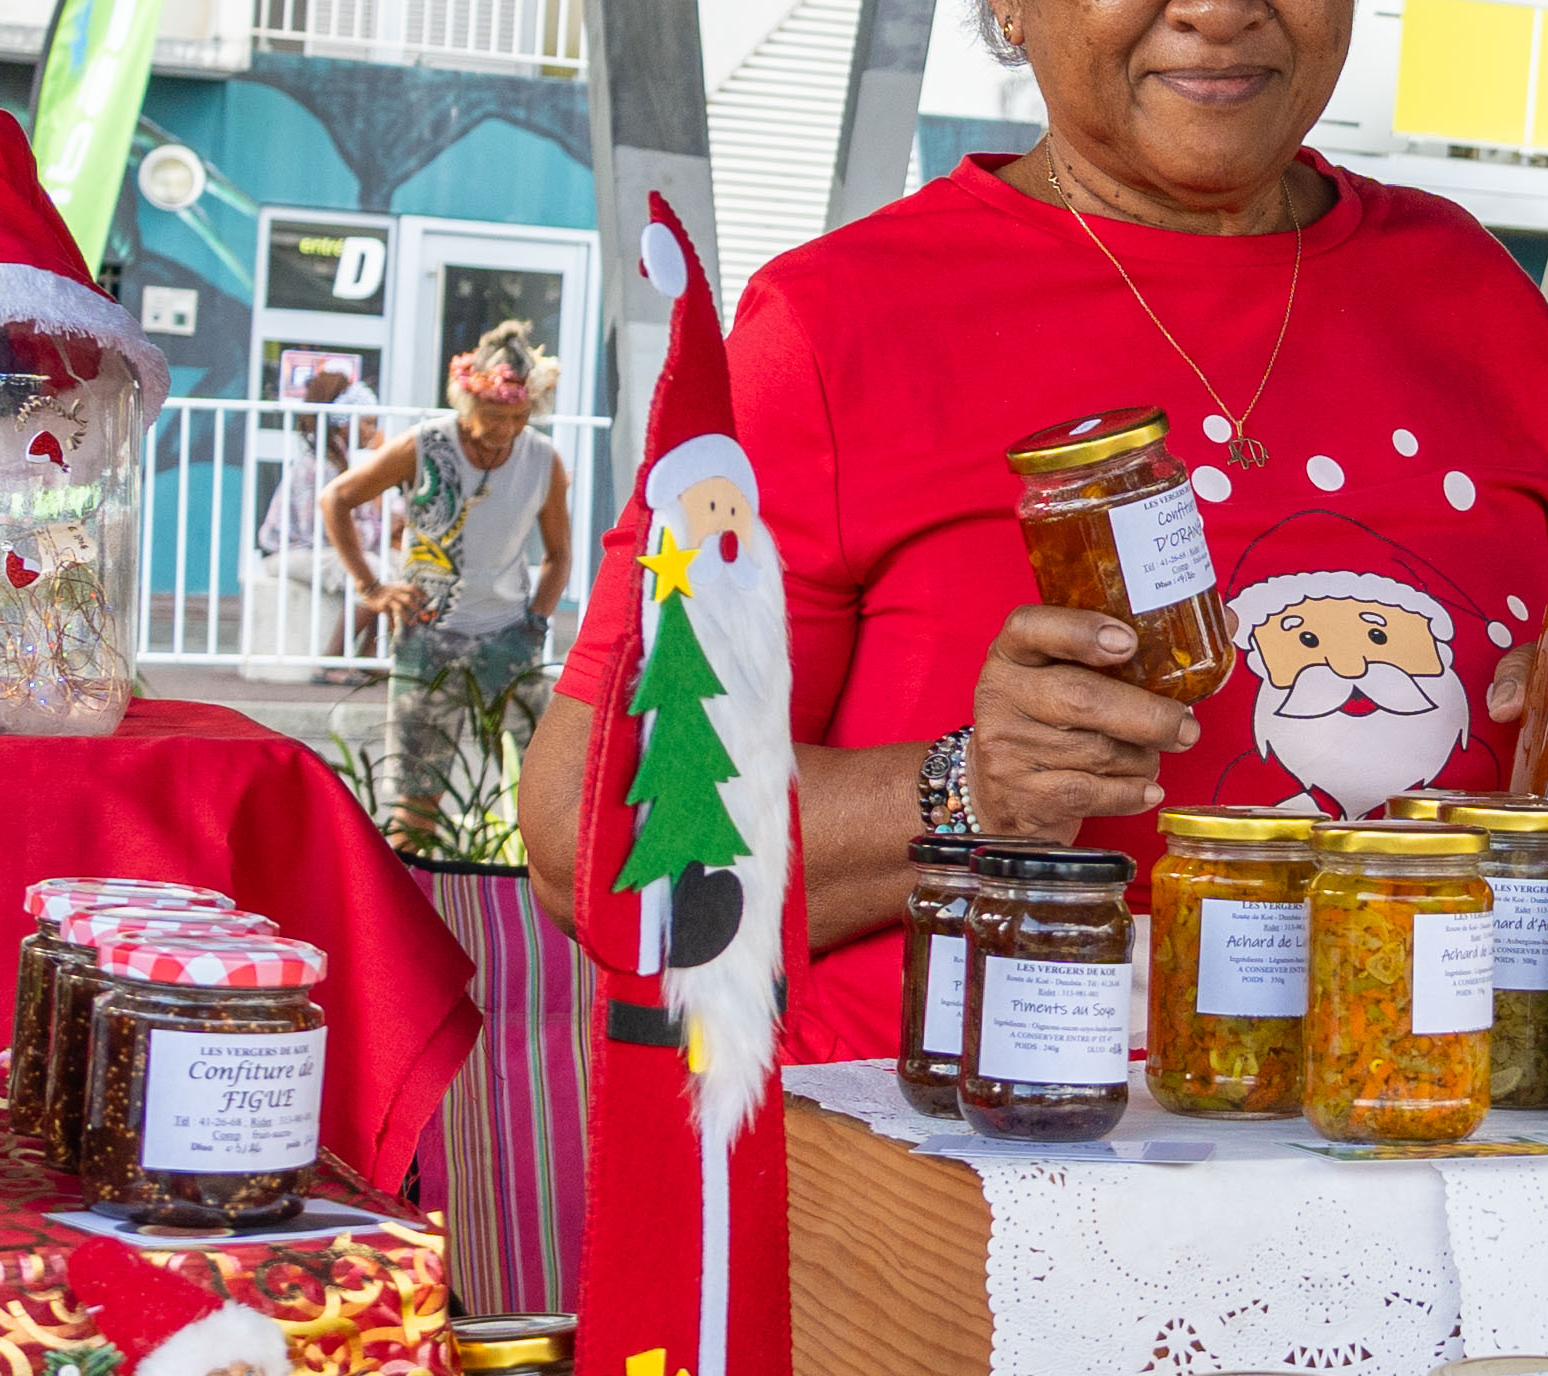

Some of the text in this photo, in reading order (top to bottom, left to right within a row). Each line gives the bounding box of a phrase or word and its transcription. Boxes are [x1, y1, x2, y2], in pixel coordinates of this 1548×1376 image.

[1494, 884, 1511, 892] LES
[1242, 901, 1303, 910] LES VERGERS
[1226, 935, 1292, 948] Achard de
[1442, 944, 1478, 962] Achard
[1016, 963, 1117, 976] LES VERGERS DE KOE
[1010, 998, 1068, 1015] Piments
[1072, 1006, 1089, 1015] au
[200, 1047, 222, 1056] LES
[227, 1047, 278, 1056] VERGERS
[188, 1060, 294, 1087] Confiture
[218, 1088, 296, 1113] FIGUE
